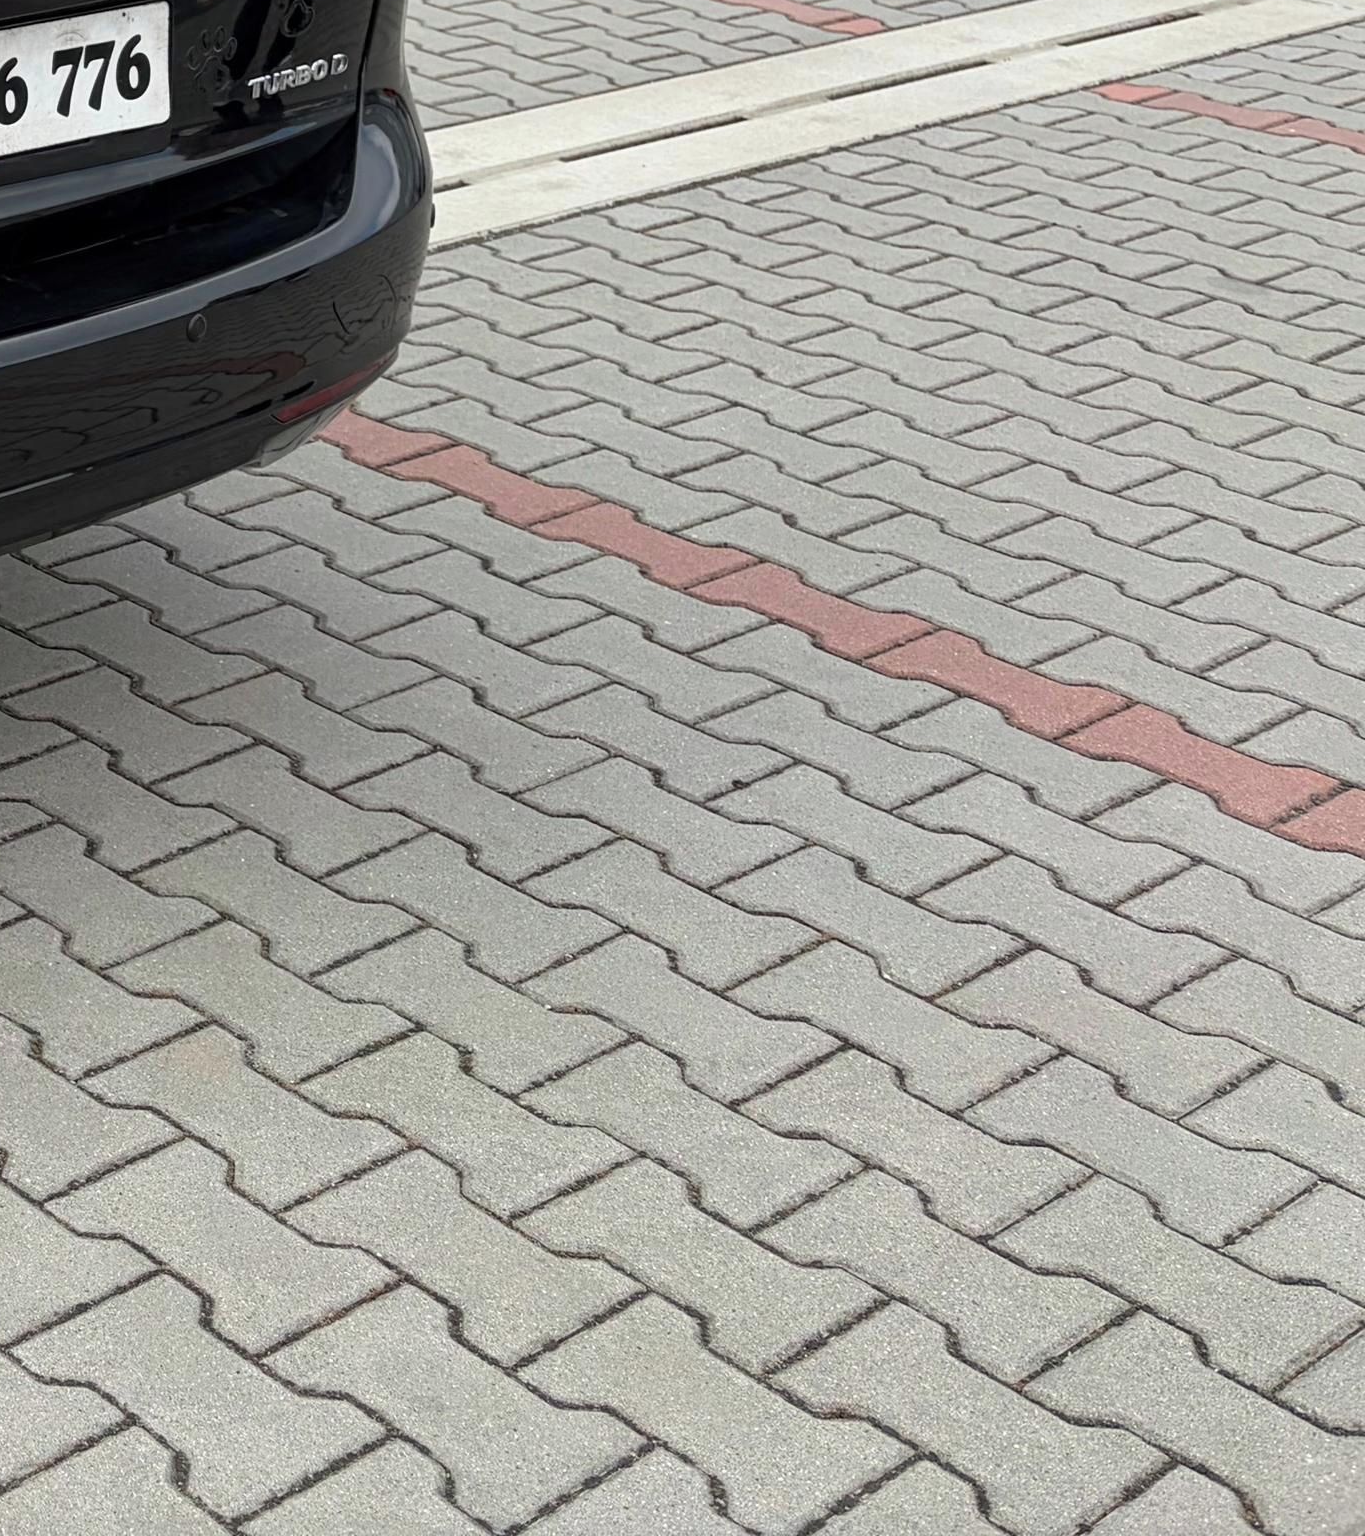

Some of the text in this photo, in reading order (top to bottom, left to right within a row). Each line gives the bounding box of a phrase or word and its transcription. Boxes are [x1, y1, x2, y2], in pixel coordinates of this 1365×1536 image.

[52, 34, 151, 117] 776
[248, 53, 349, 99] TURBO D
